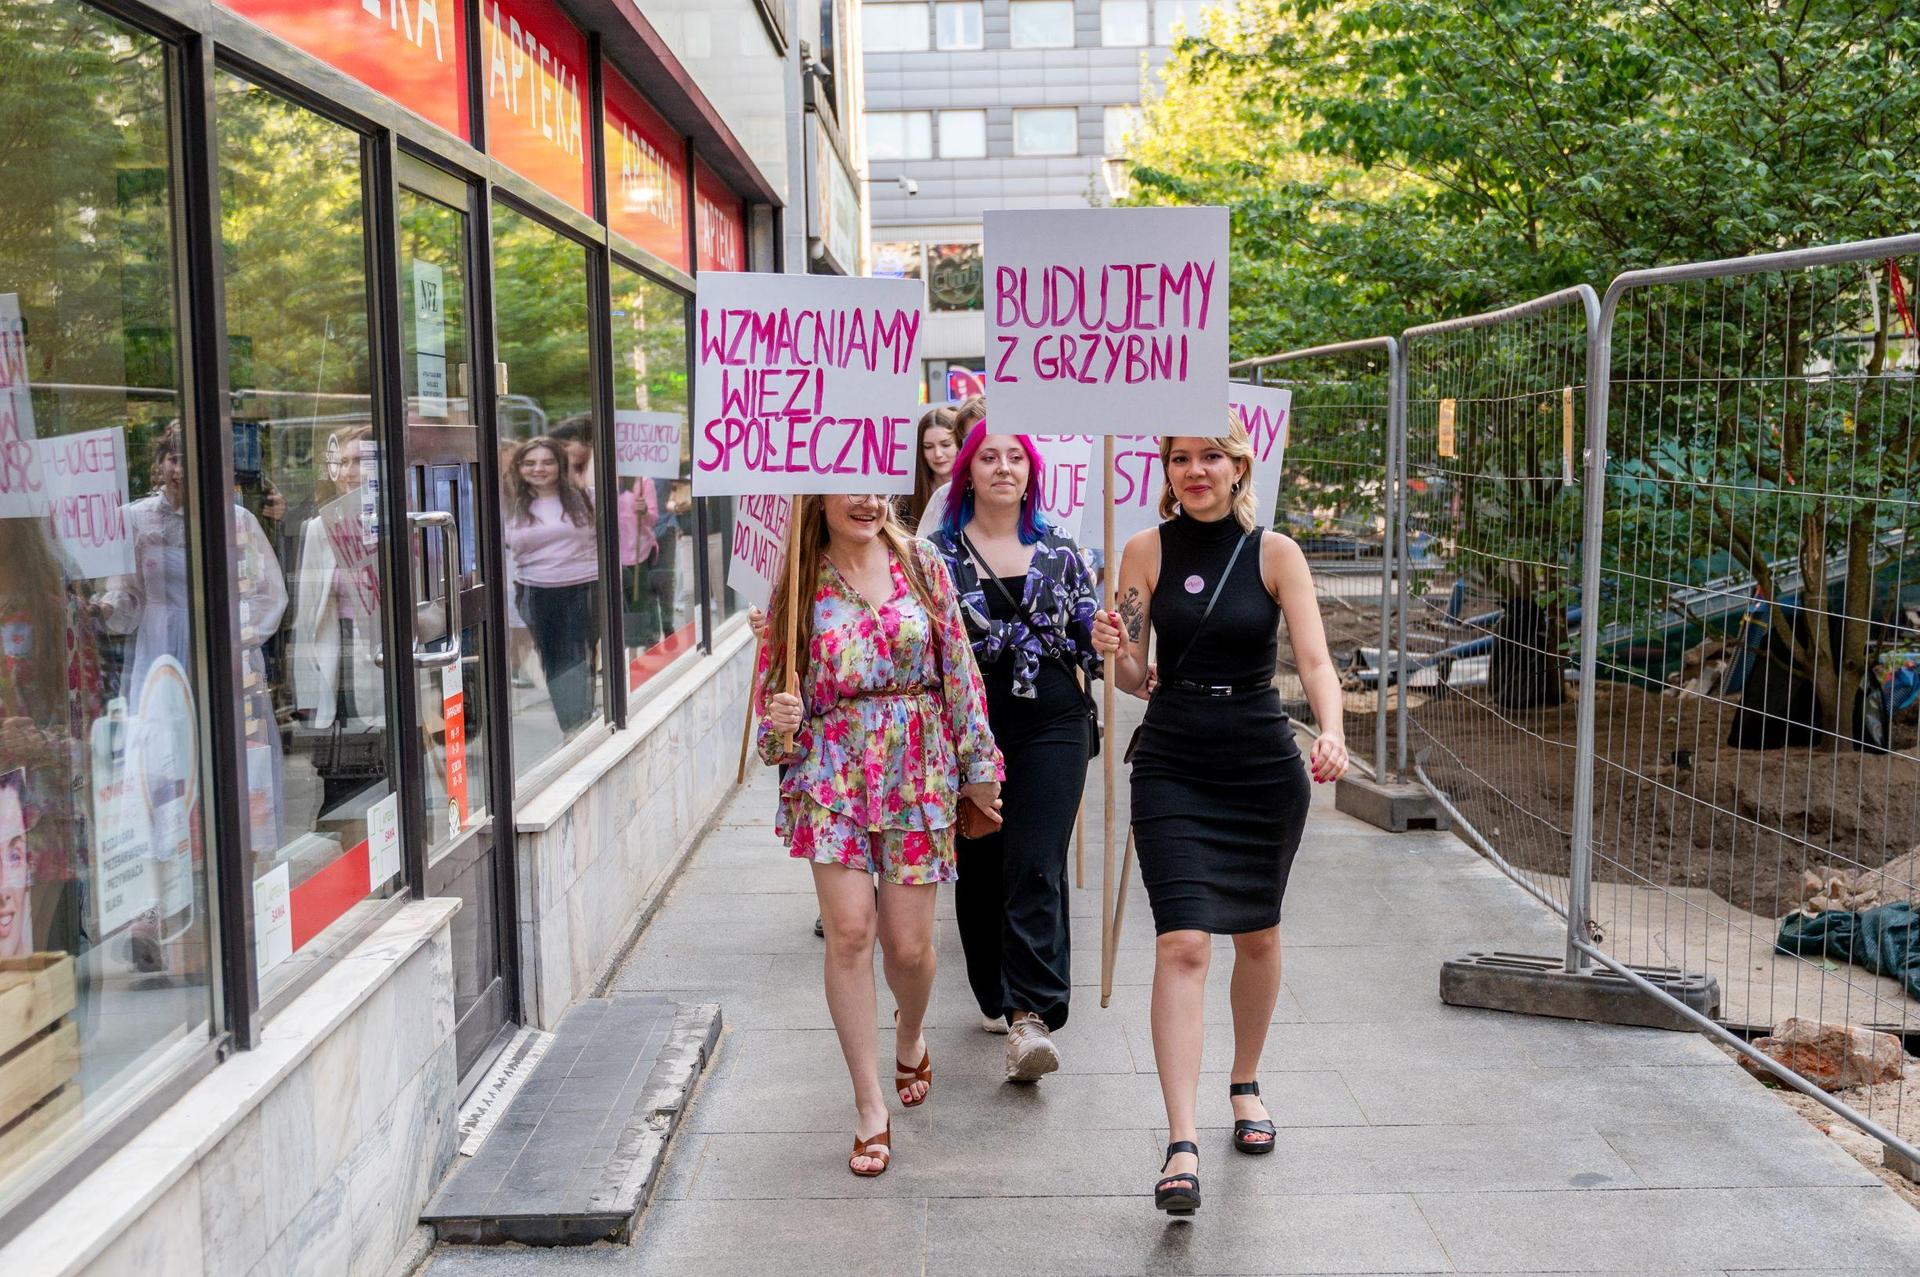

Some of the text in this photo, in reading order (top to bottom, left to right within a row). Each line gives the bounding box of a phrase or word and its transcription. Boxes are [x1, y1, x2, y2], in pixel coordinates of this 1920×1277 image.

[490, 1, 584, 164] APTEKA
[996, 259, 1215, 333] BUDUJEMY
[701, 307, 920, 374] WZMACNIAMY
[994, 334, 1188, 384] Z GRZYBNI
[697, 416, 911, 475] SPOŁECZNE
[734, 520, 750, 560] DO
